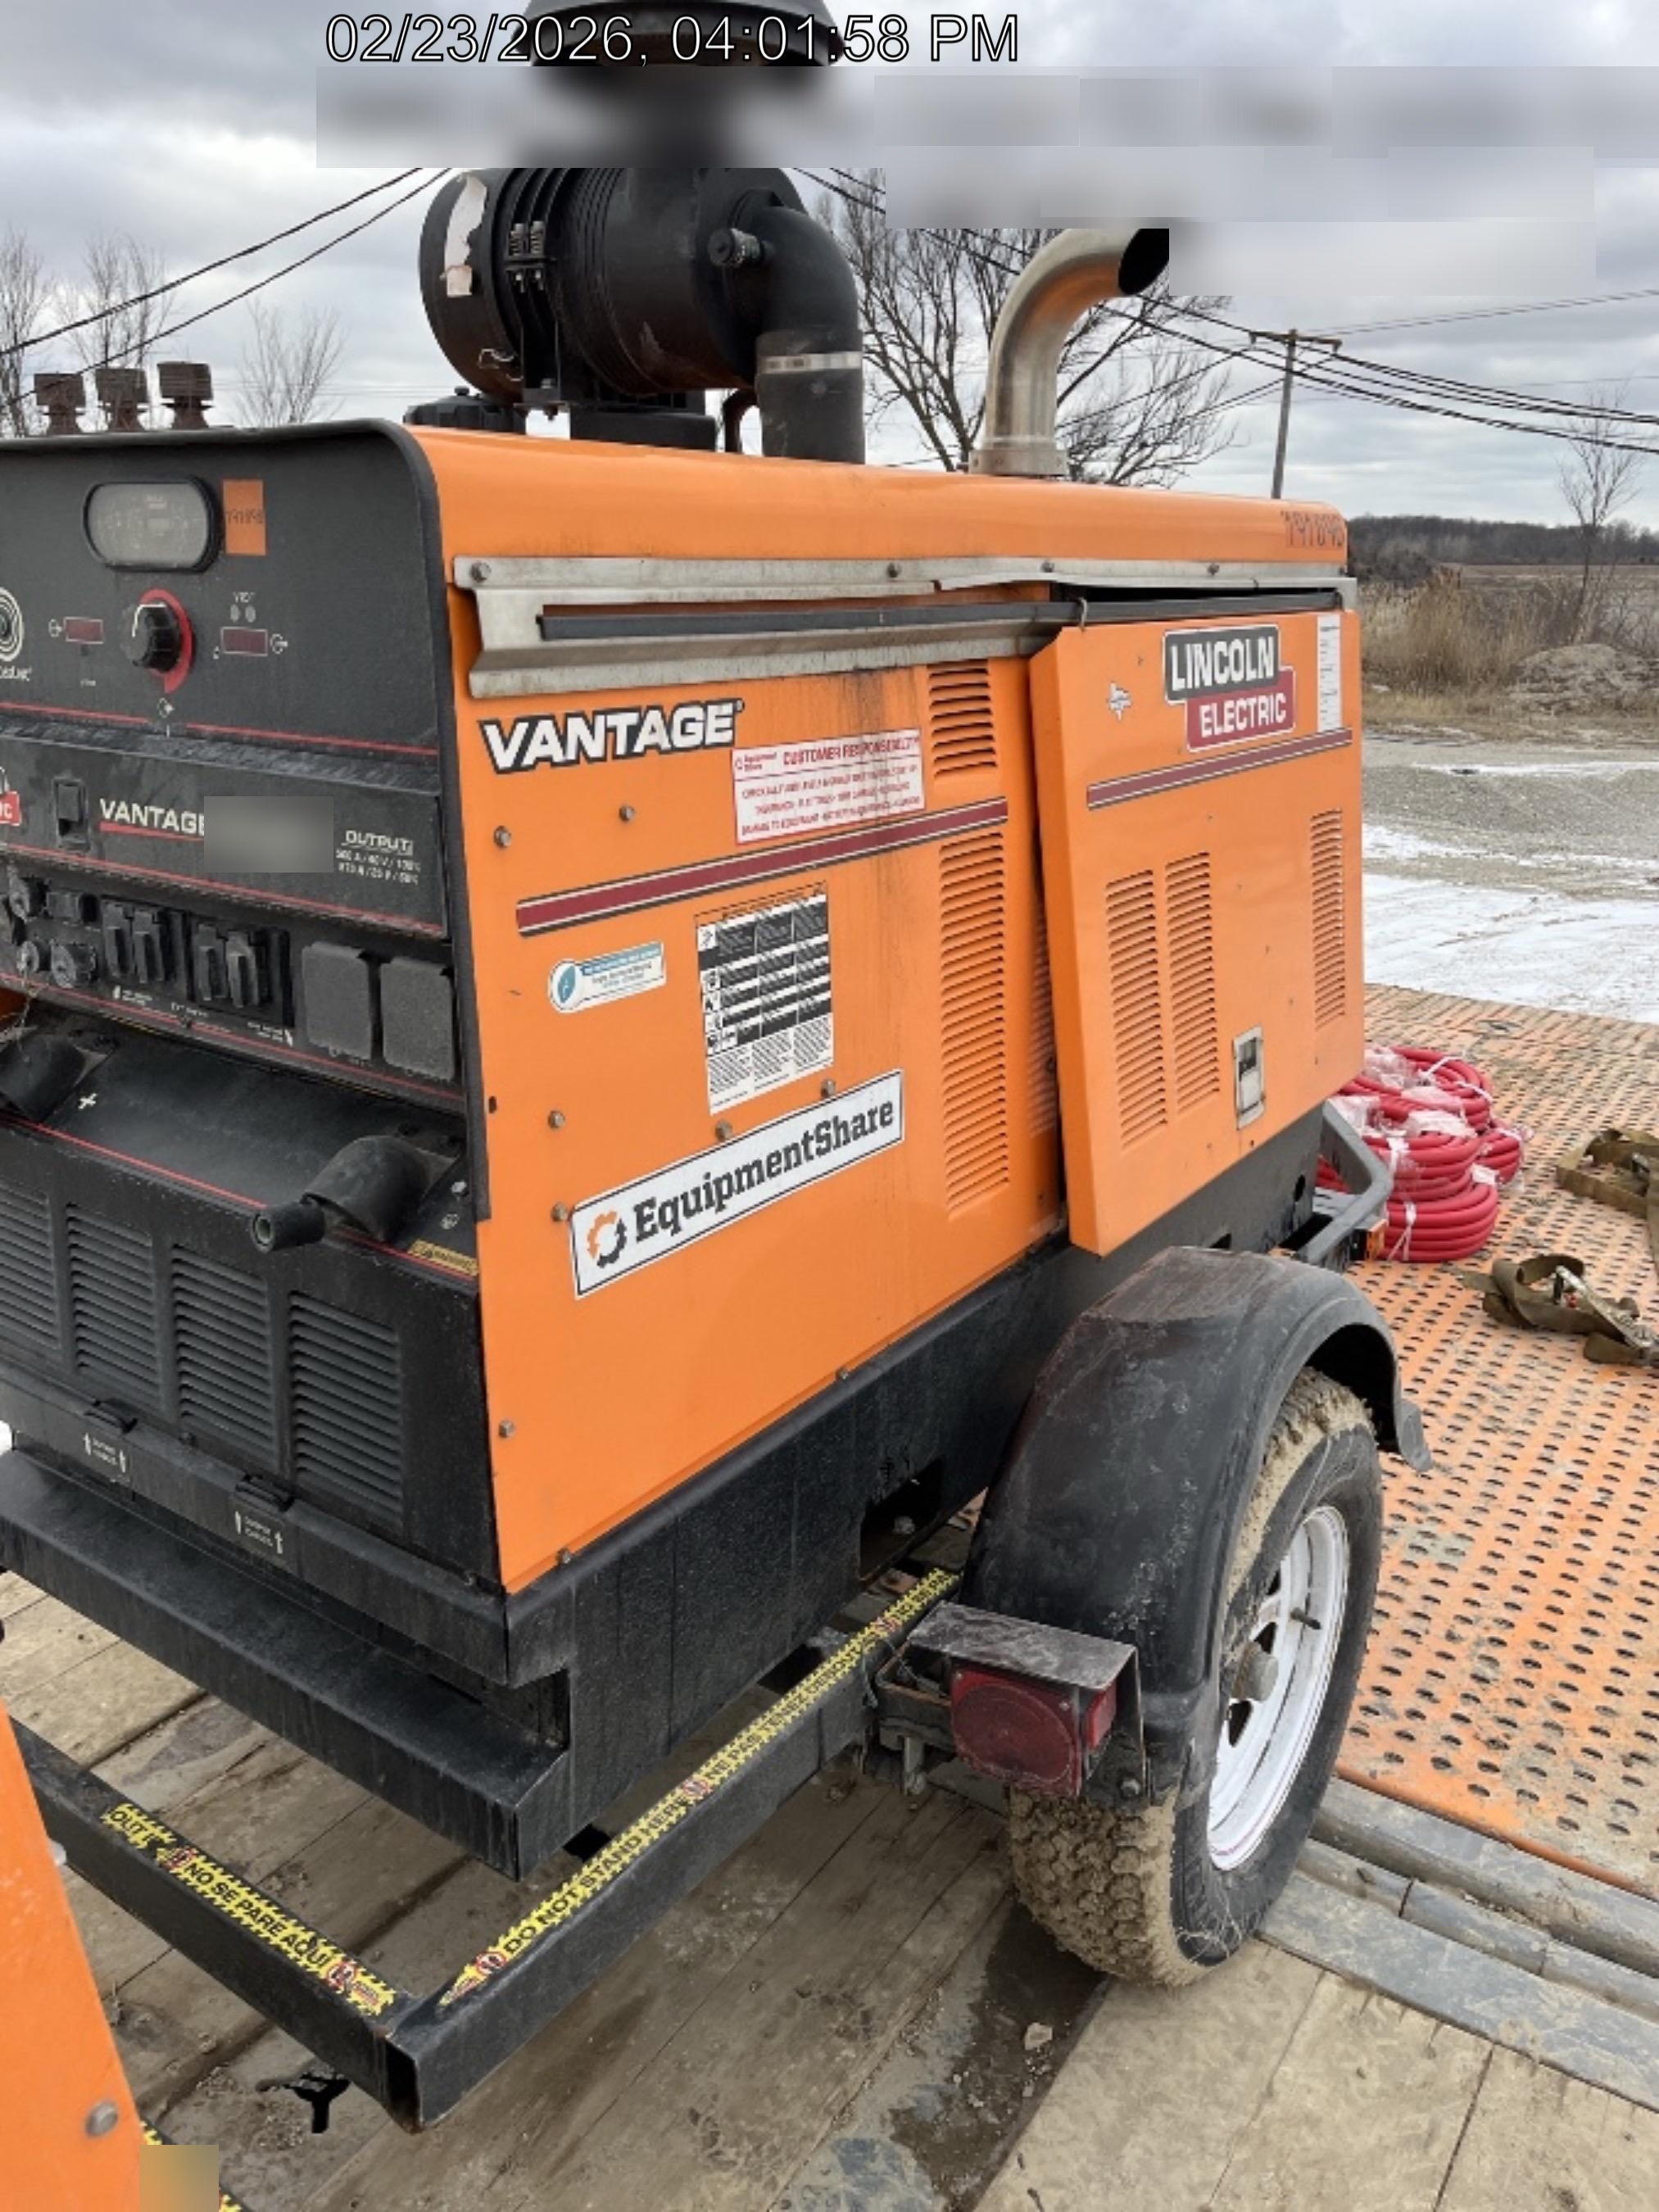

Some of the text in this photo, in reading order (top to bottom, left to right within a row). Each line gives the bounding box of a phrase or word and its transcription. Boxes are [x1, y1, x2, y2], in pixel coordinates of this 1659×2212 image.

[1171, 636, 1275, 691] LINCOLN
[1199, 692, 1287, 738] ELECTRIC
[633, 1100, 894, 1244] EquipmentShare
[184, 1862, 214, 1884] NO
[211, 1883, 240, 1902] SE
[235, 1898, 288, 1937] PARE
[504, 1926, 537, 1954] DO
[537, 1888, 578, 1926] NOT
[579, 1834, 641, 1888] STAND
